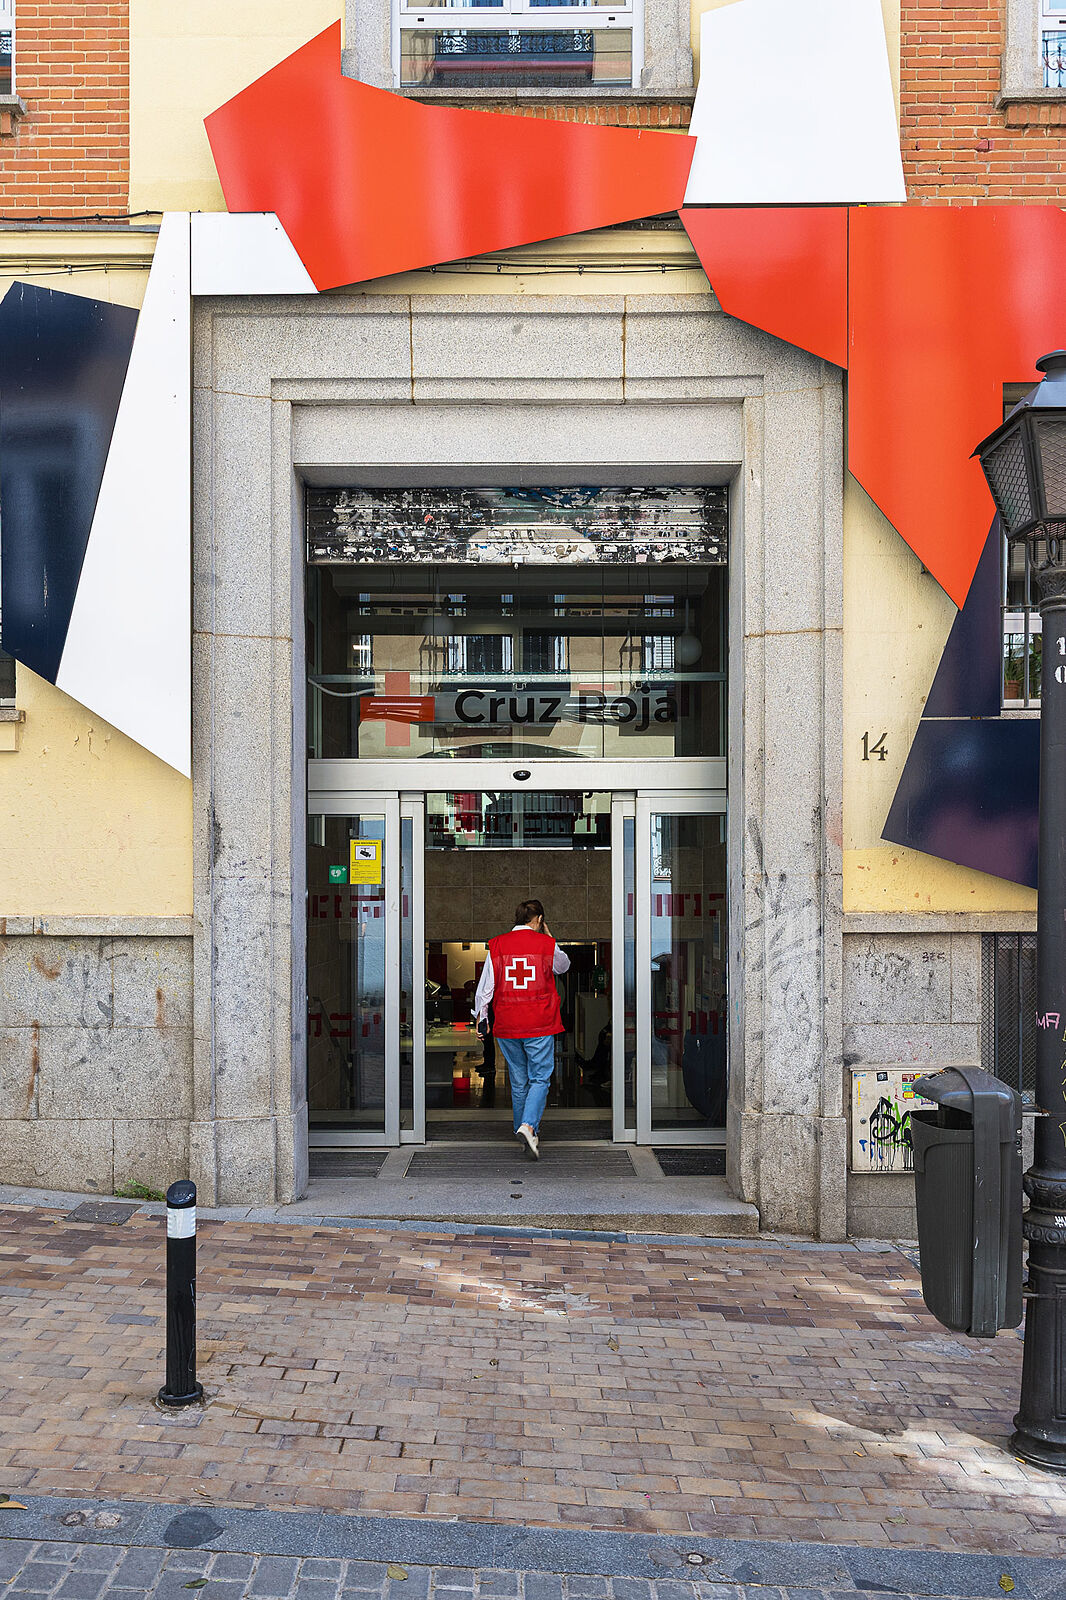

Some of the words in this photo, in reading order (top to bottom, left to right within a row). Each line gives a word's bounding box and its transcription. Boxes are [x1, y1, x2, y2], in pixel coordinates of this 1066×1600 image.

[455, 690, 561, 723] Cruz
[579, 685, 678, 732] Roja
[861, 731, 889, 761] 14
